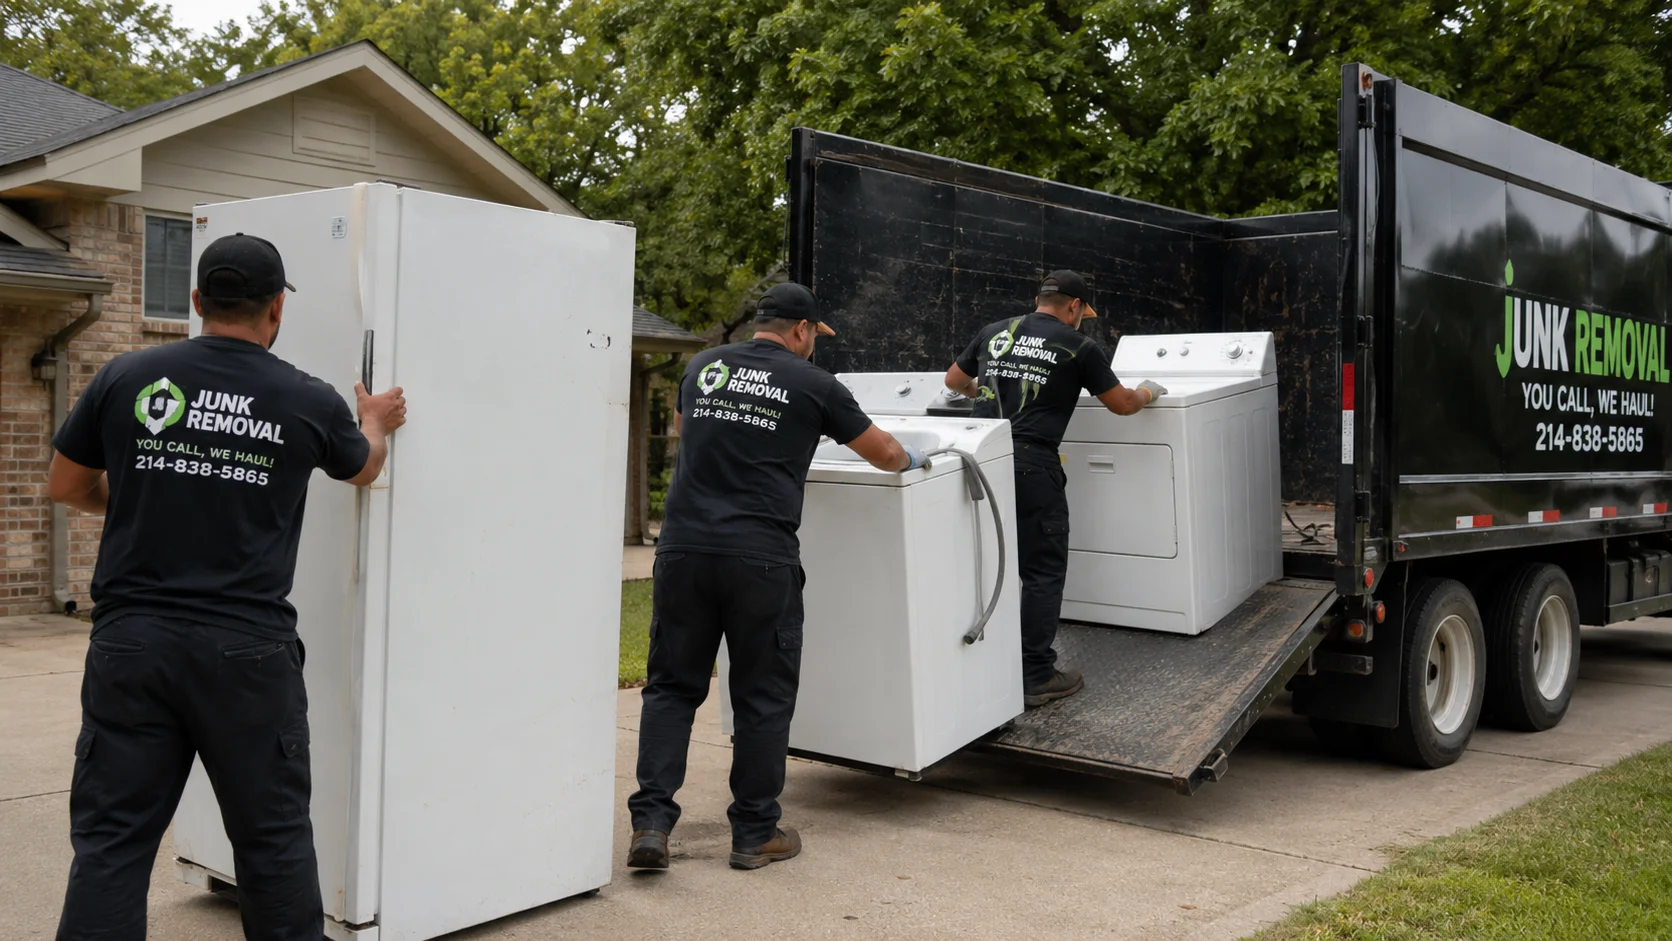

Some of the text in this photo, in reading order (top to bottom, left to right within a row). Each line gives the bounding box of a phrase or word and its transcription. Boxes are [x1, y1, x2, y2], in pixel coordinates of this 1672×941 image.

[1011, 345, 1057, 364] REMOVAL
[1015, 335, 1046, 348] JUNK
[1575, 309, 1671, 383] REMOVAL
[732, 367, 772, 384] JUNK
[190, 389, 254, 416] JUNK
[727, 379, 790, 404] REMOVAL
[1522, 382, 1654, 418] YOU CALL, WE HAUL!
[693, 408, 777, 431] 214-838-5865
[739, 403, 752, 411] WE
[754, 406, 782, 419] HAUL!
[186, 409, 285, 445] REMOVAL
[1535, 422, 1644, 453] 214-838-5865
[136, 439, 275, 468] YOU CALL, WE HAUL!
[135, 455, 269, 486] 214-838-5865
